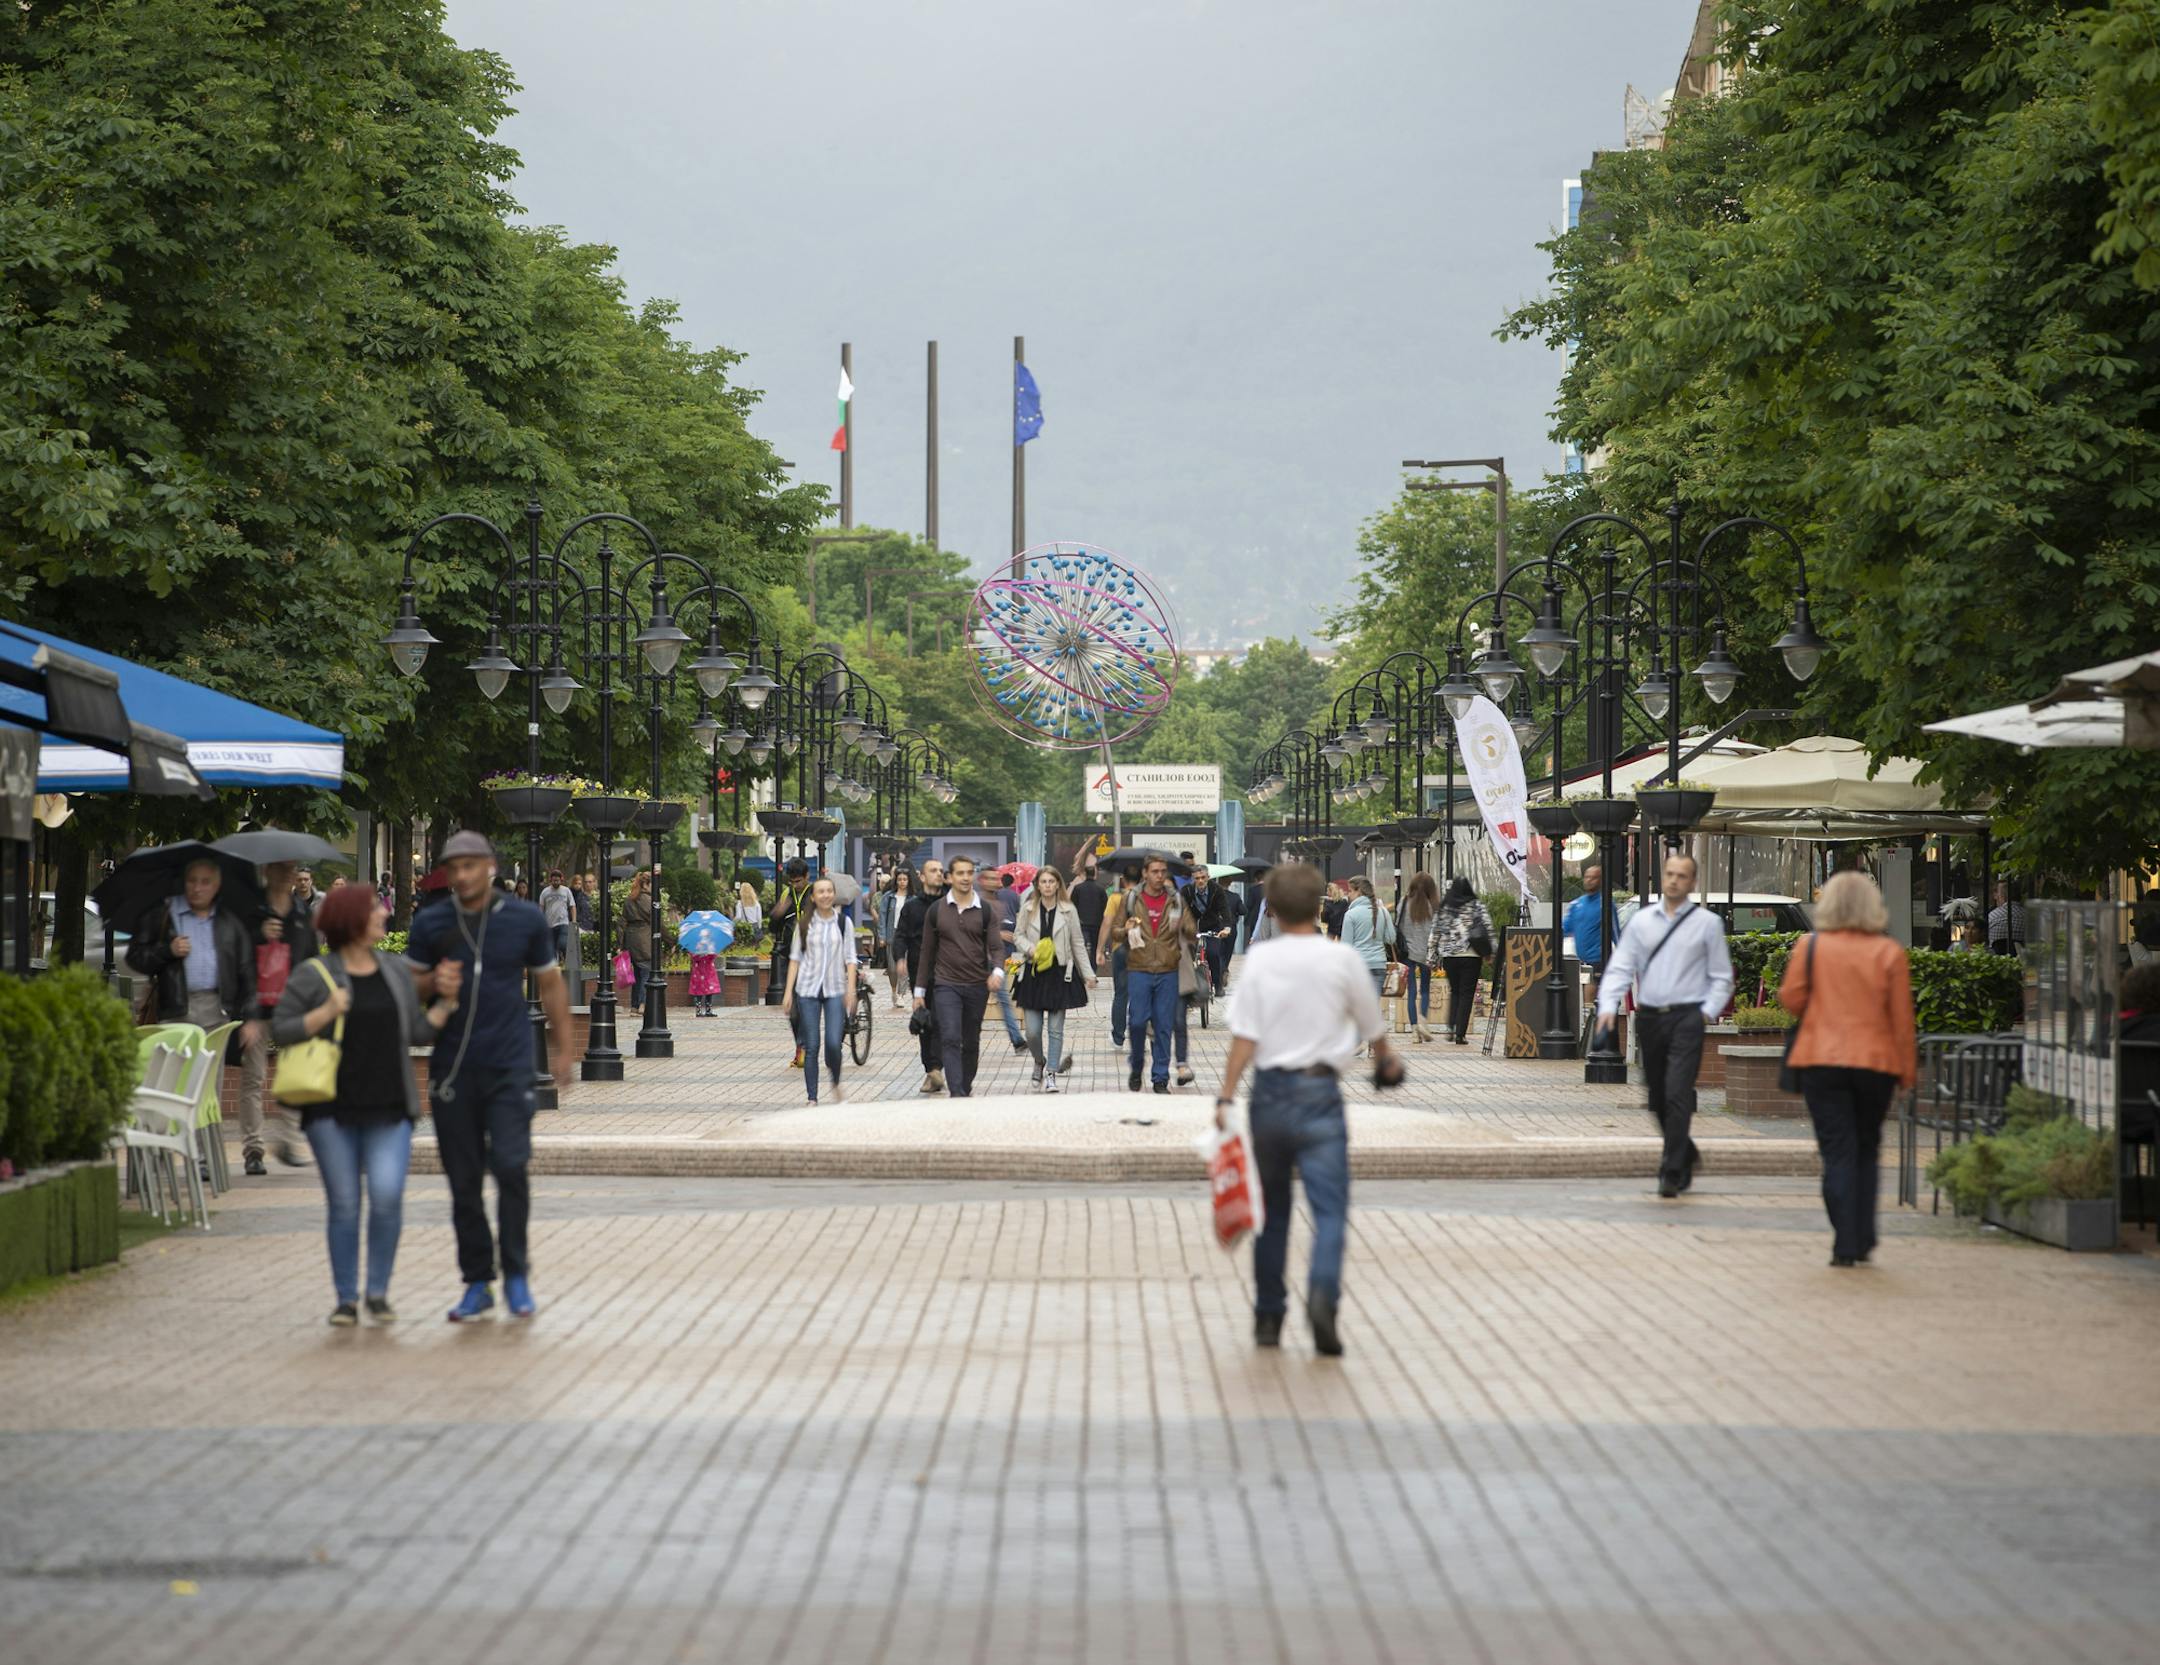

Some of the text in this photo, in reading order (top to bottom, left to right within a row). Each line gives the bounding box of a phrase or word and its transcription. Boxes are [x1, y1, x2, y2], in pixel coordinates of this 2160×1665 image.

[222, 752, 243, 761] DER
[244, 752, 273, 763] WELT
[1127, 773, 1216, 783] СТАНИЛОВ ЕООД
